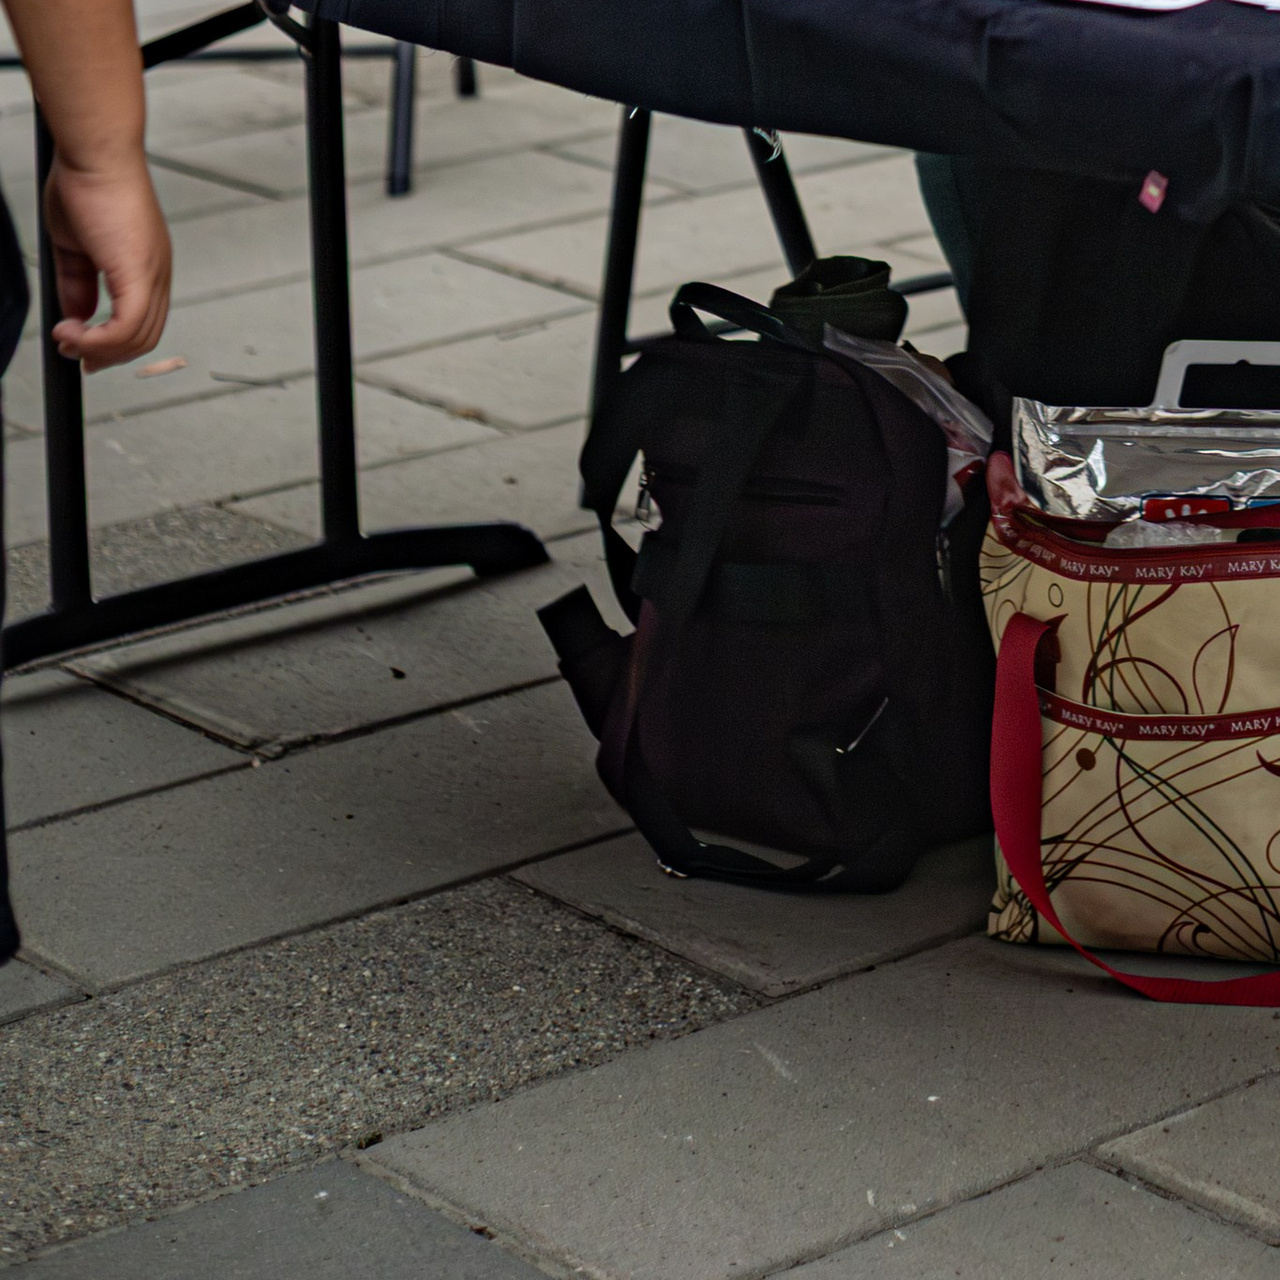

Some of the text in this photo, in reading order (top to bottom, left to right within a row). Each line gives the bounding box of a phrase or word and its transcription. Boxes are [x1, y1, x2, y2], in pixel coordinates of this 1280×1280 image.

[1136, 566, 1175, 579] MARY
[1227, 558, 1265, 573] MARY
[1061, 708, 1092, 727] MARY
[1139, 724, 1177, 736] MARY
[1230, 717, 1271, 733] MARY
